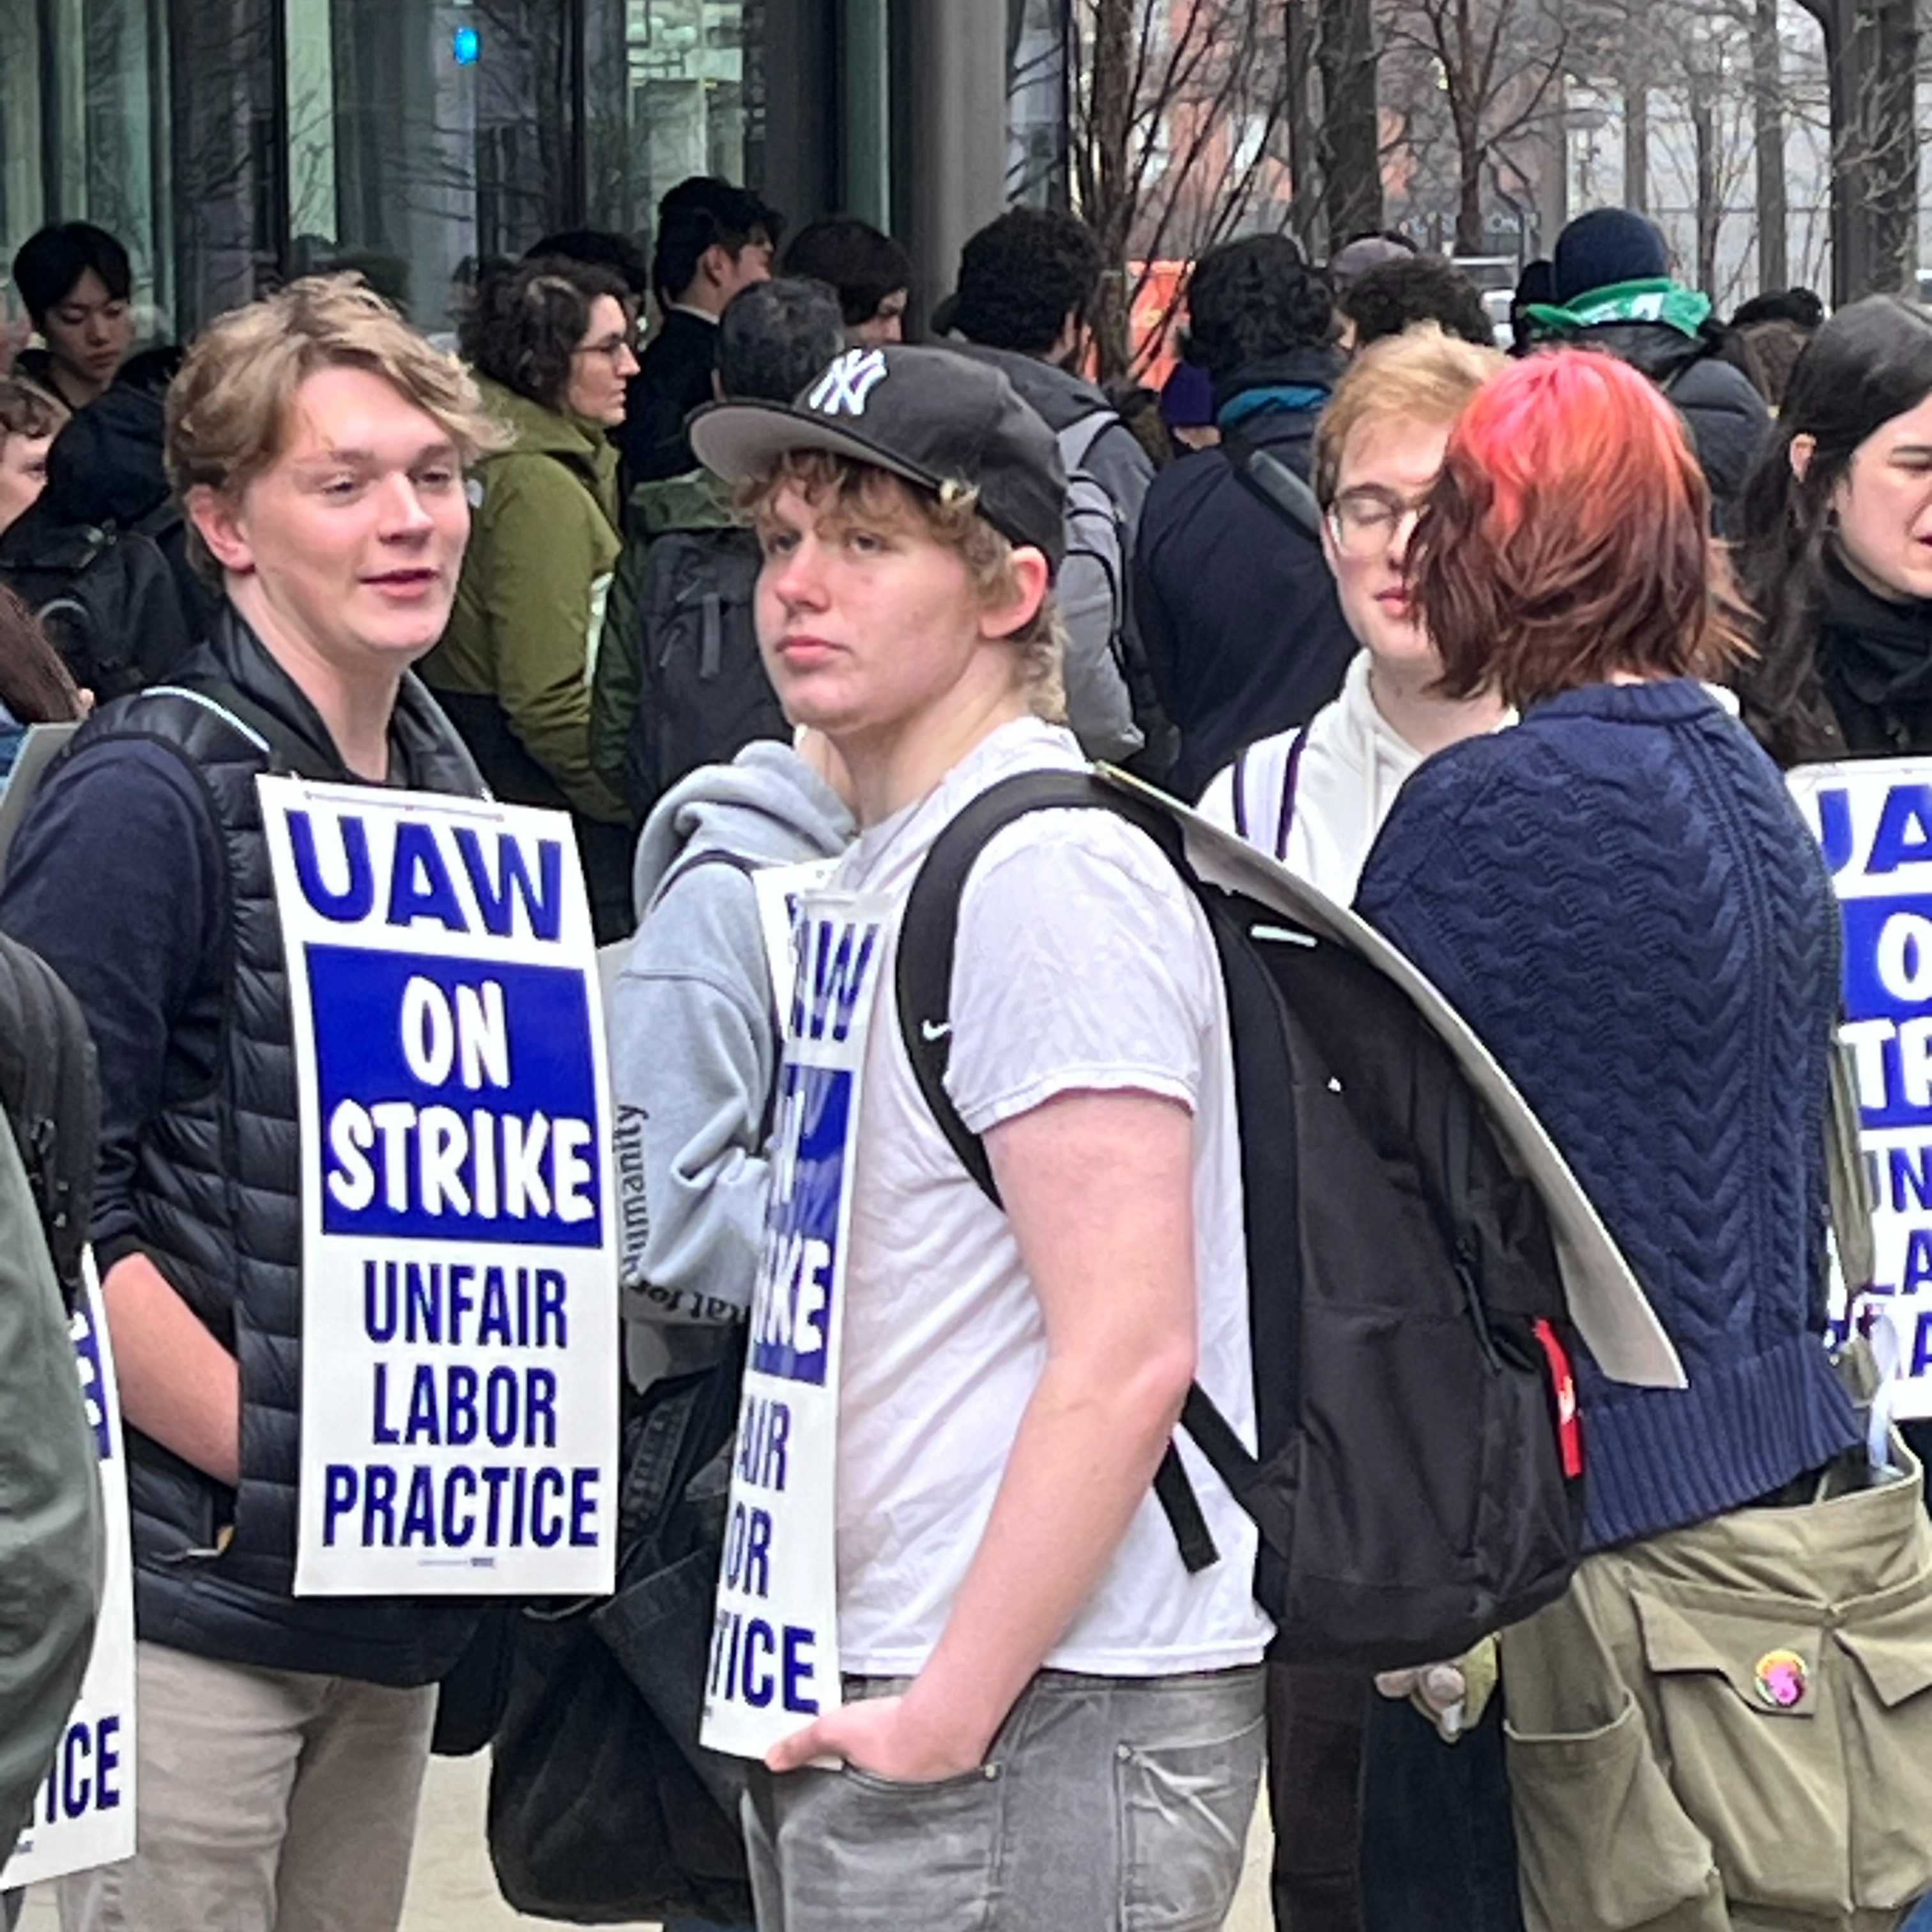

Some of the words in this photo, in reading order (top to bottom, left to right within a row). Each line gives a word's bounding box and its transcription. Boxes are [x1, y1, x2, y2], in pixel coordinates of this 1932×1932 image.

[809, 348, 887, 415] NY
[284, 808, 562, 943] UAW
[401, 975, 510, 1089] ON
[328, 1098, 595, 1223] STRIKE
[364, 1260, 567, 1349] UNFAIR
[372, 1362, 557, 1448] LABOR
[323, 1463, 601, 1548] PRACTICE
